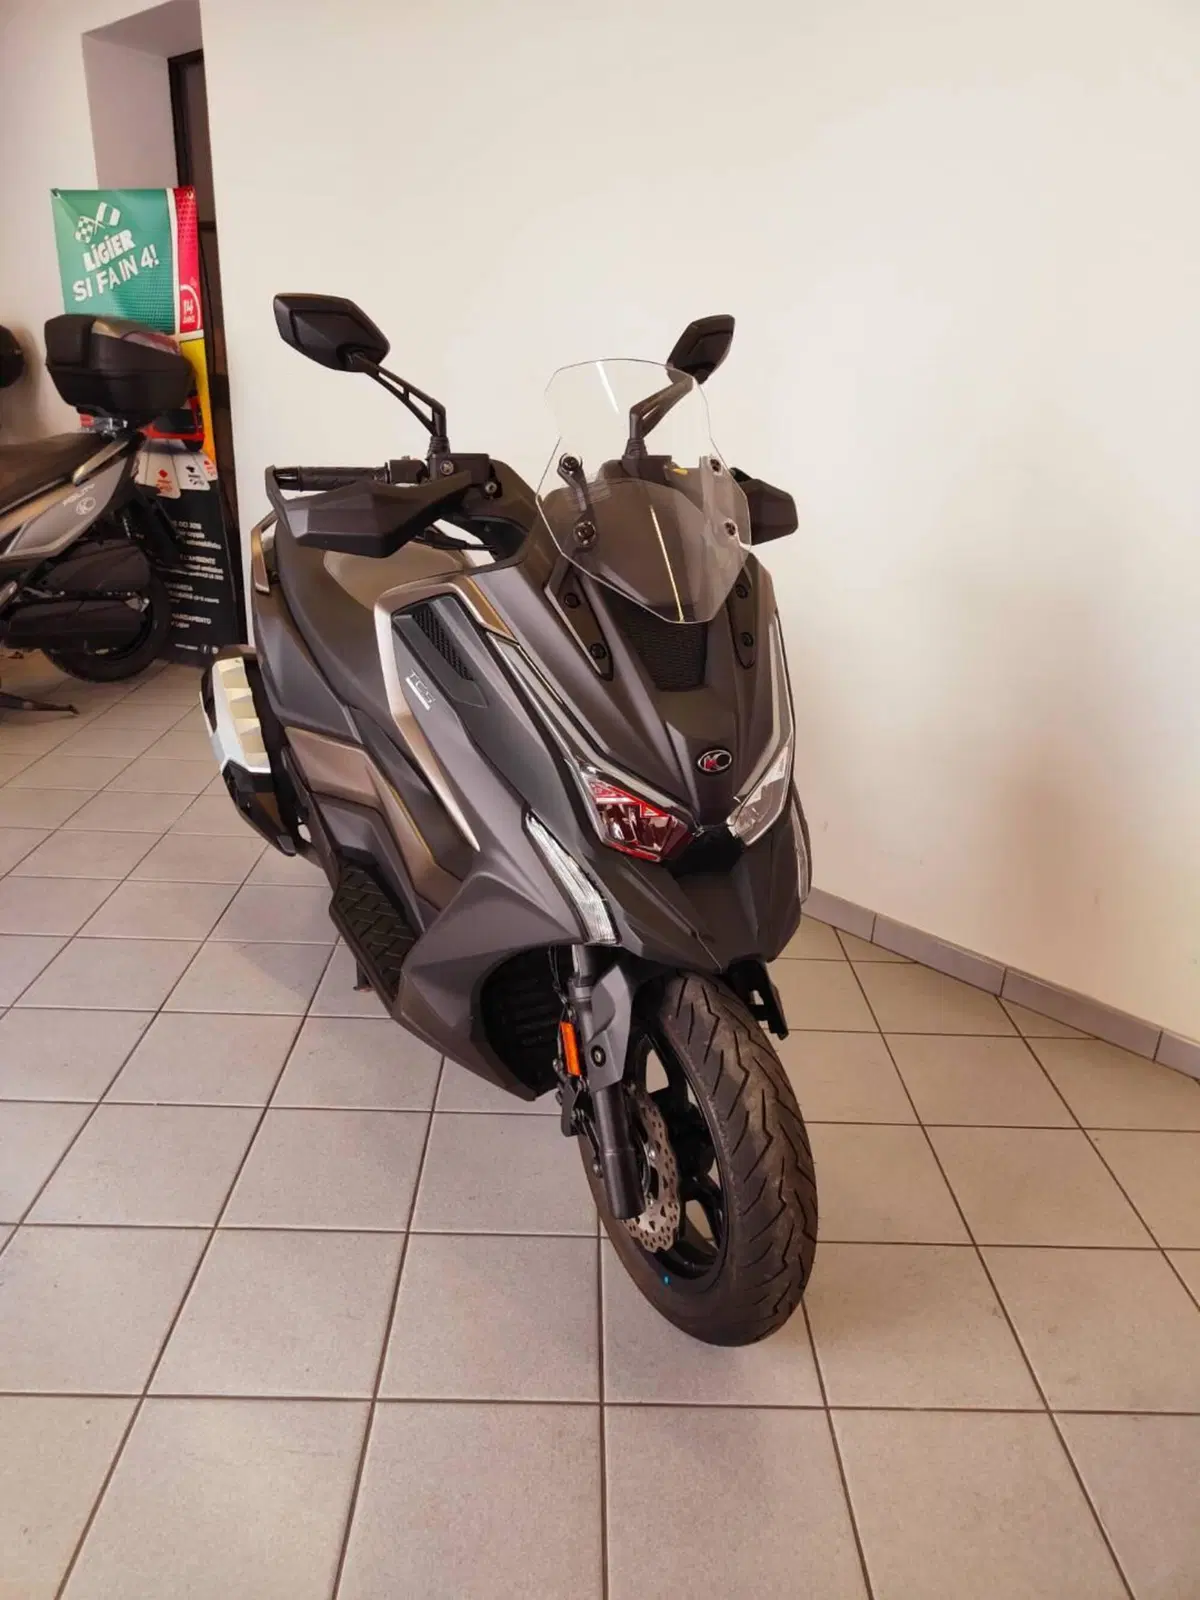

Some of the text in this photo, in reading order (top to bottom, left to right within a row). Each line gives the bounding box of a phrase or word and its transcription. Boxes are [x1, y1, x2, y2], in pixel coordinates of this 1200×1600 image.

[72, 244, 160, 302] SI FA IN 4!
